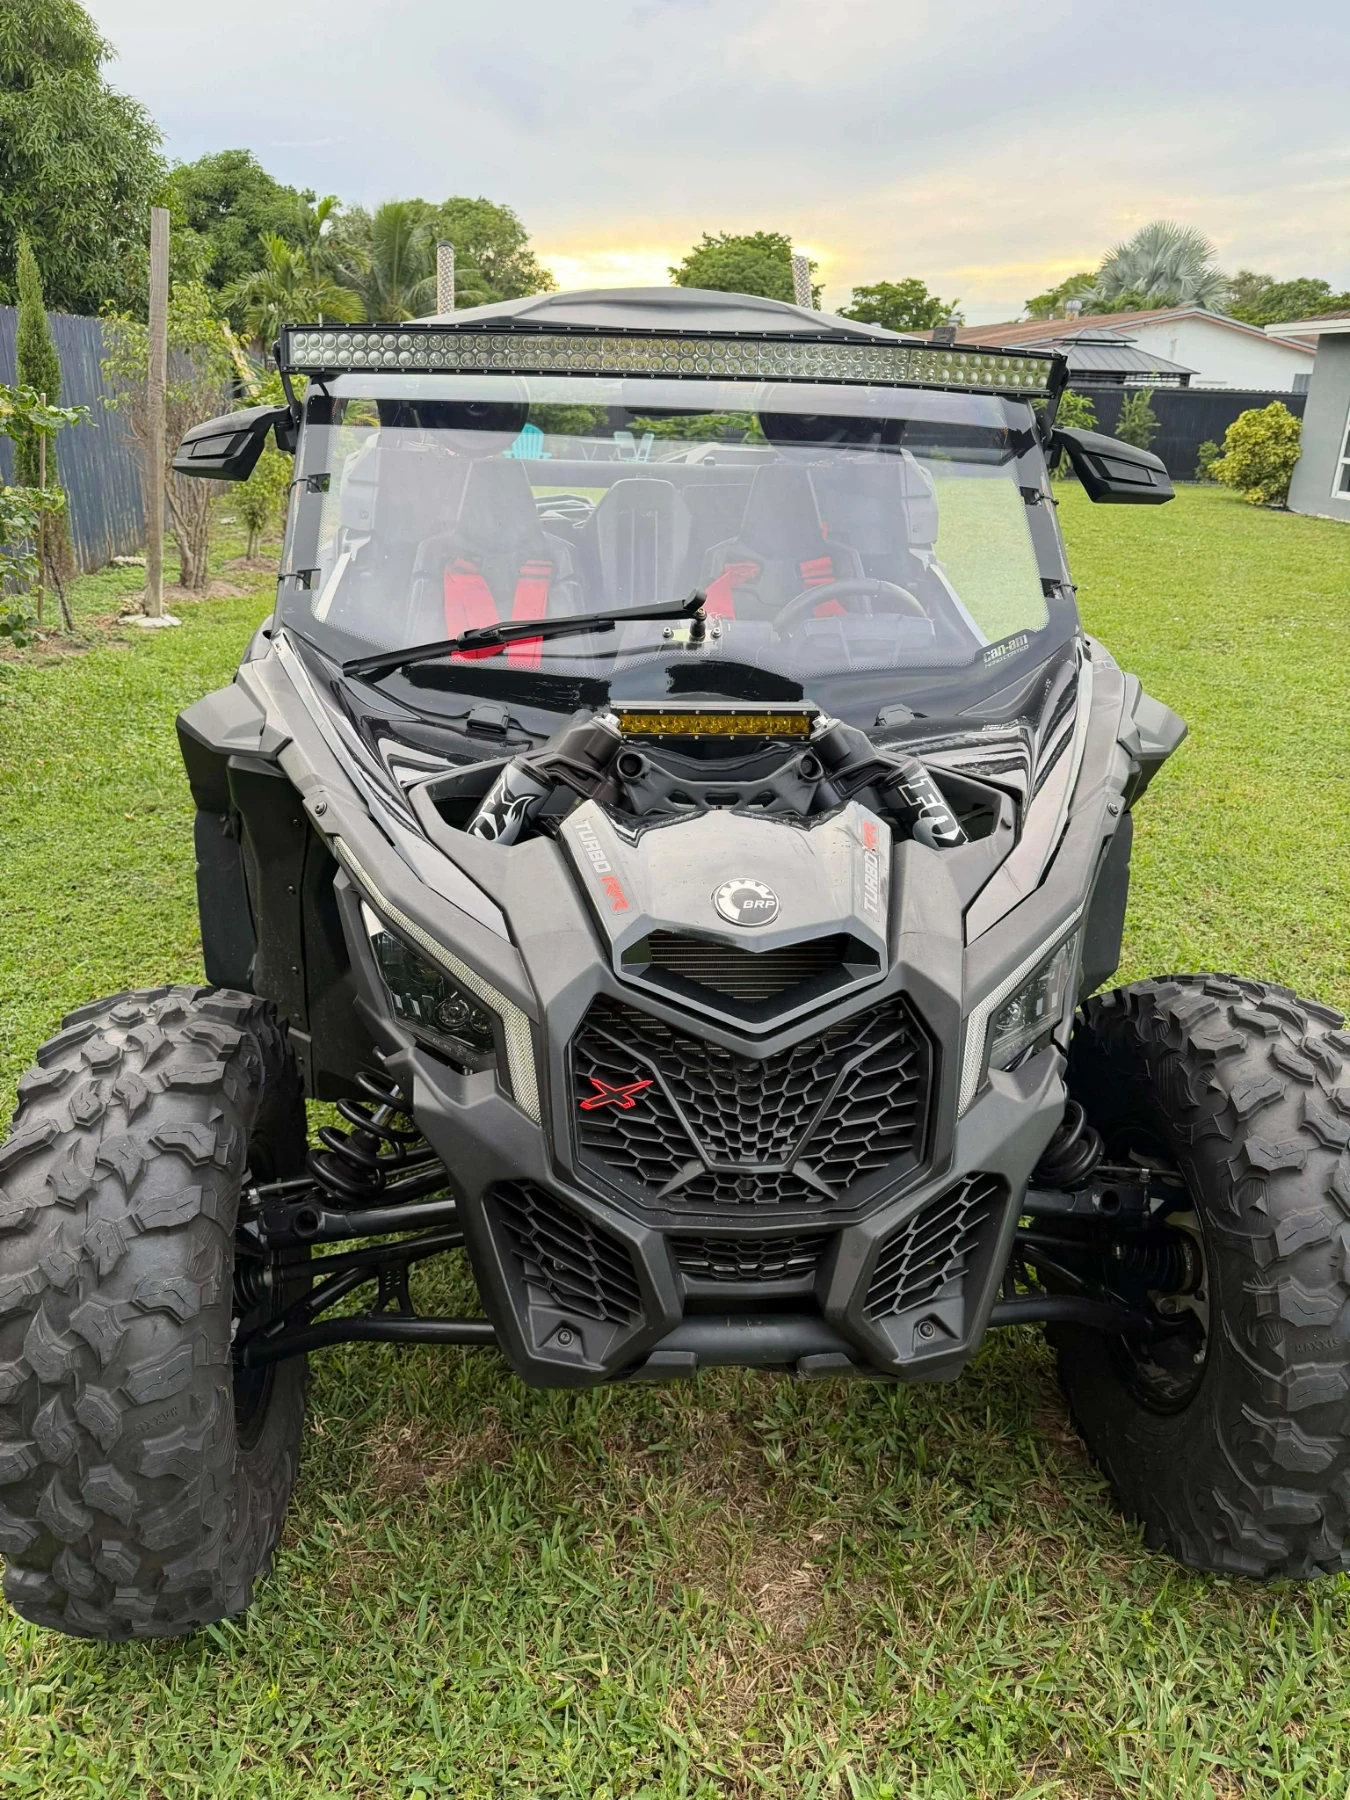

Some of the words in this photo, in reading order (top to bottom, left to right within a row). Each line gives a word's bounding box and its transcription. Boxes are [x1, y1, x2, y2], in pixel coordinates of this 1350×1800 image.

[983, 634, 1028, 663] can-am
[898, 777, 968, 846] FO
[575, 820, 612, 874] TURBO
[600, 875, 630, 914] RR
[863, 849, 879, 914] TURBO
[742, 899, 776, 909] BRP
[1295, 1337, 1340, 1353] MAXXIS
[133, 1405, 179, 1434] MAXXIS
